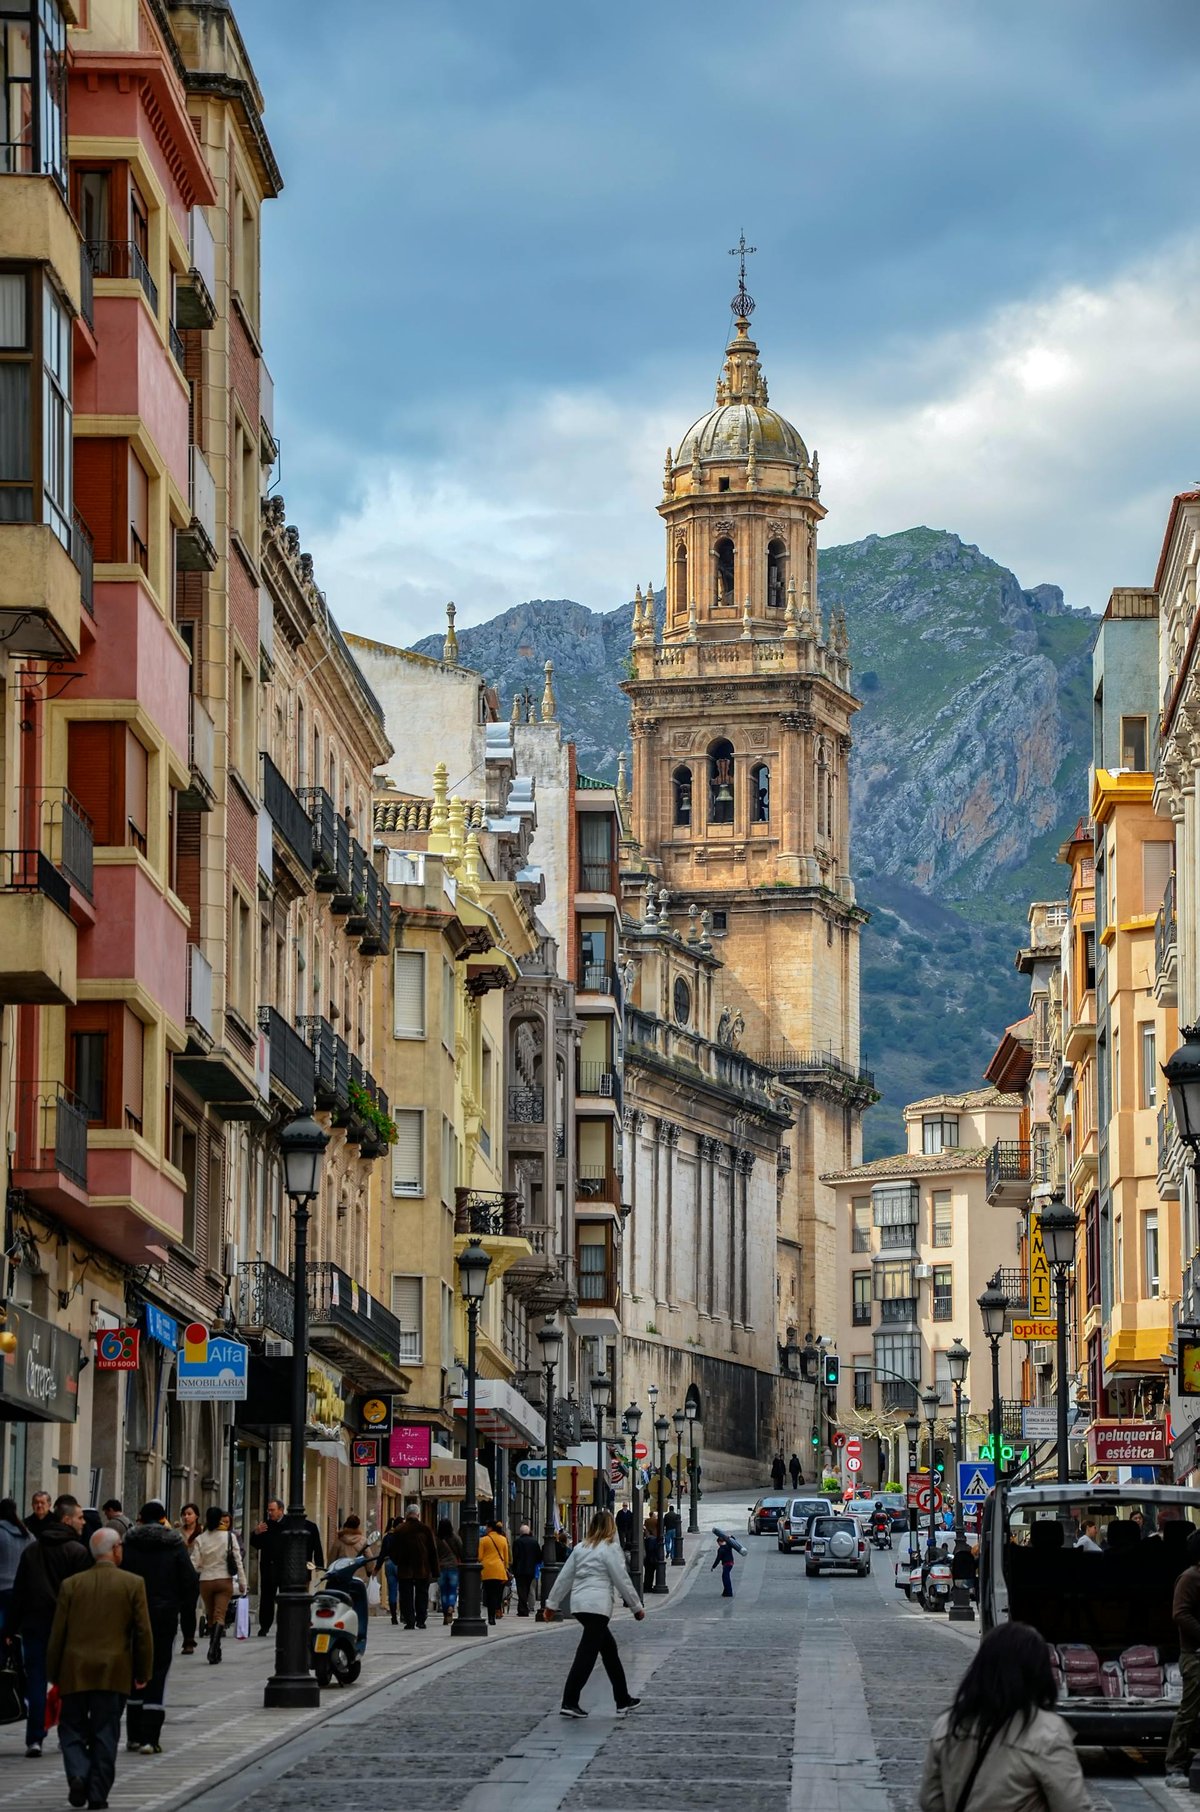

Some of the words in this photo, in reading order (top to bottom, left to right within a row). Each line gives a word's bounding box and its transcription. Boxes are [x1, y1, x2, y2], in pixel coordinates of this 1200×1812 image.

[1014, 1323, 1058, 1338] optica
[209, 1346, 243, 1363] Alfa
[178, 1379, 245, 1387] INMOBILIARIA
[402, 1428, 419, 1437] Flor
[1097, 1427, 1162, 1445] peluquería
[1106, 1445, 1155, 1459] estética
[424, 1475, 435, 1487] LA
